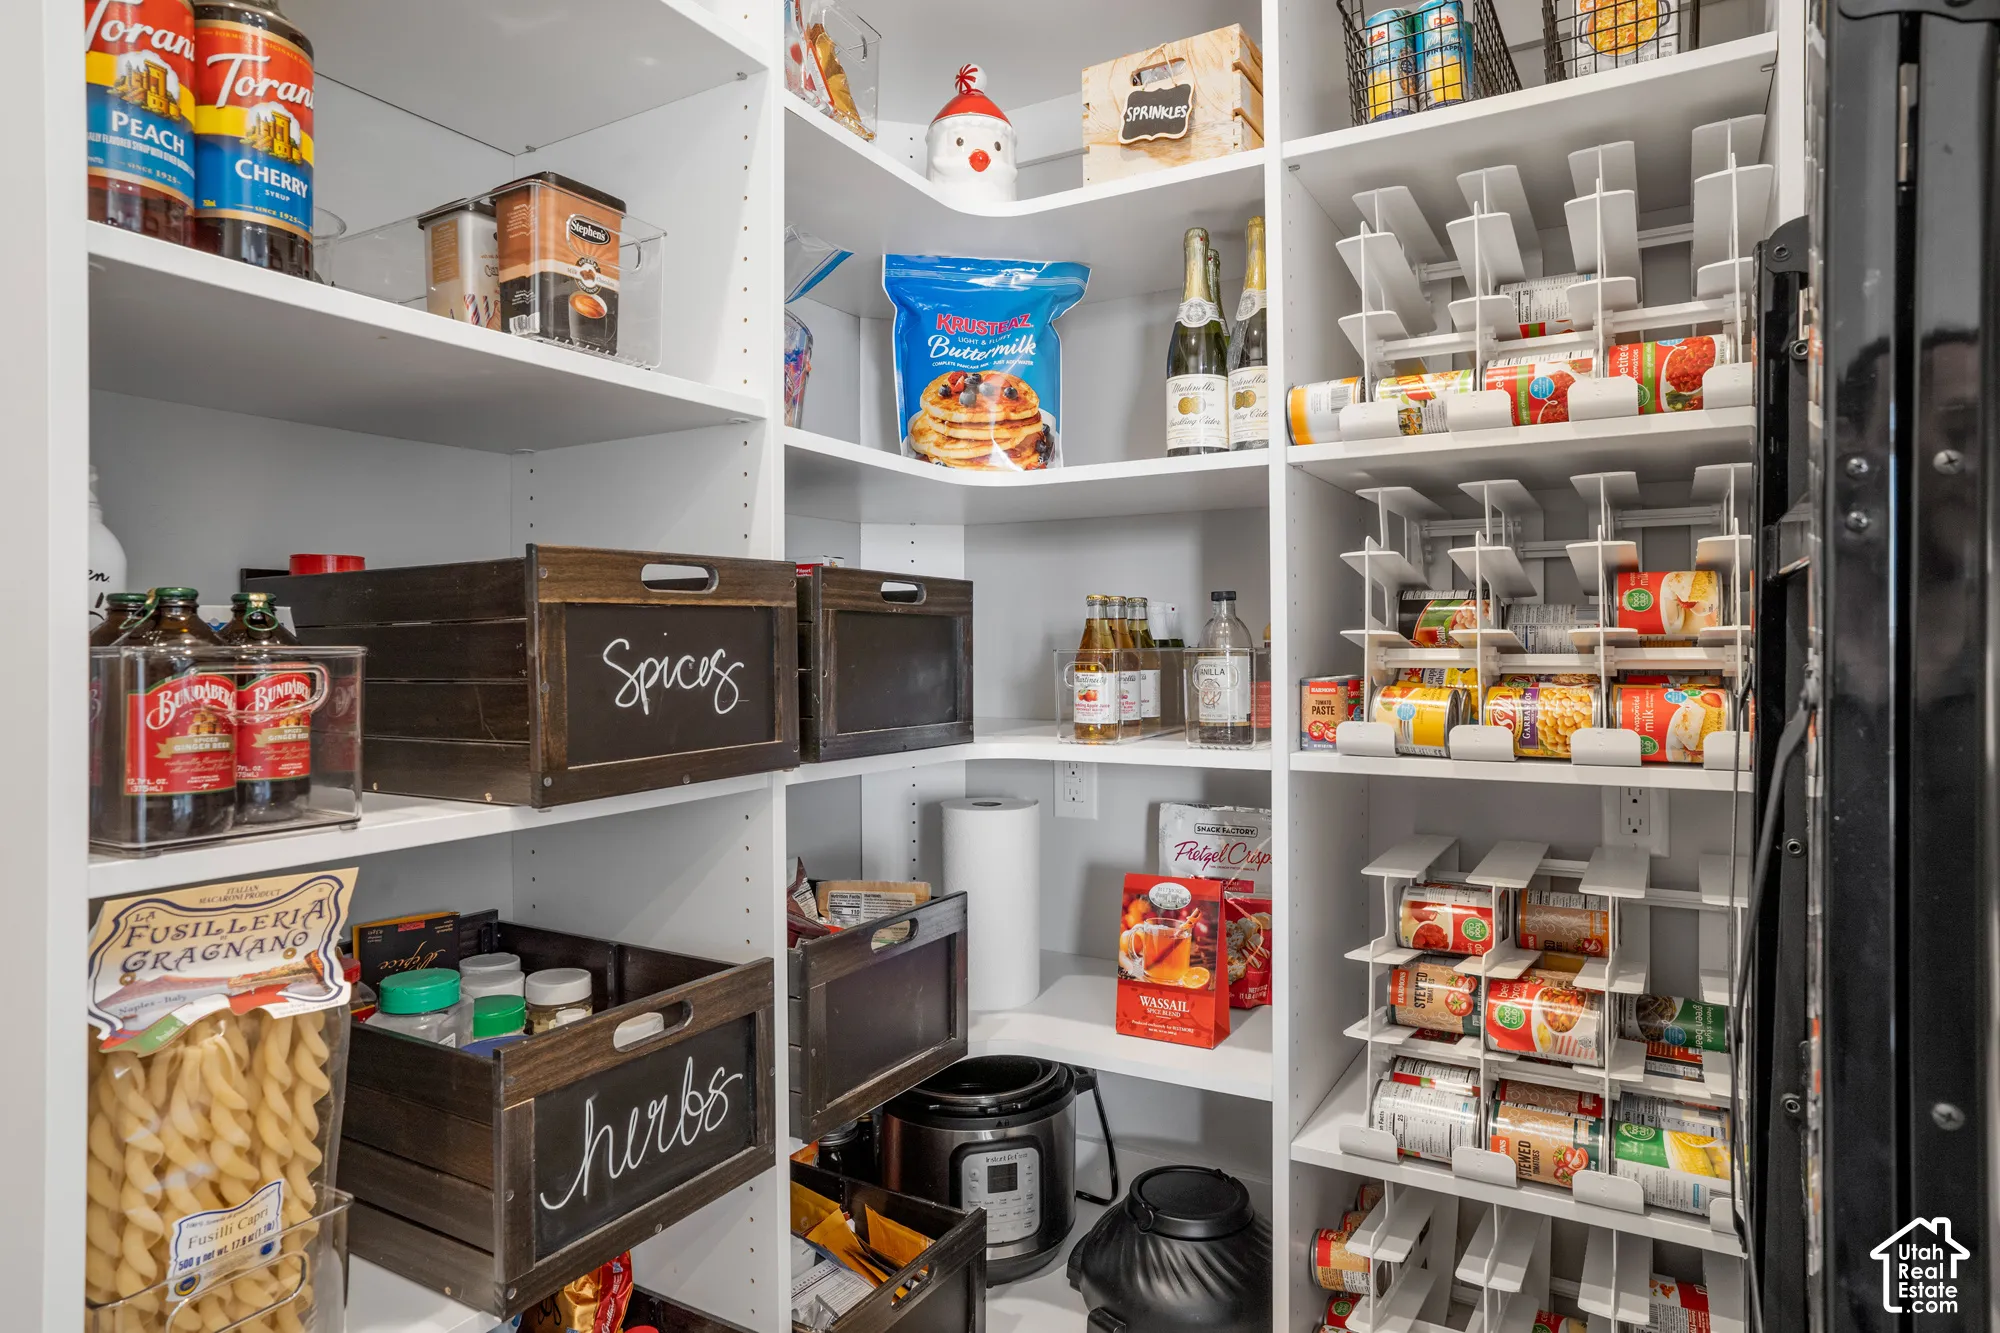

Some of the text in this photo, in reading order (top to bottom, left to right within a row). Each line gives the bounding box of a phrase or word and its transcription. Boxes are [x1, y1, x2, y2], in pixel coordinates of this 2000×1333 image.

[1426, 46, 1464, 57] PINAPPLE
[1126, 105, 1188, 122] SPRINKLES
[111, 110, 185, 156] PEACH
[127, 162, 177, 184] SINCE 1925
[235, 159, 309, 198] CHERRY
[265, 189, 291, 202] SYRUP
[255, 206, 298, 223] SINCE 1925
[571, 220, 606, 242] Stephen's
[927, 334, 1037, 361] Buttermilk
[958, 336, 978, 345] LIGHT
[1199, 415, 1222, 426] Cider
[1637, 572, 1649, 586] mil
[602, 633, 745, 715] Spices
[1199, 668, 1226, 676] ANILLA
[1311, 705, 1336, 716] PASTE
[1632, 695, 1641, 732] evaporated
[1642, 708, 1654, 732] milk
[173, 743, 210, 752] GINGER
[1197, 825, 1221, 833] SNACK
[1174, 840, 1272, 872] Pretzel Crisp
[199, 888, 283, 905] MACARONI PRODUCT
[226, 884, 260, 895] ITALIAN
[121, 897, 326, 949] FUSILLERIA
[134, 910, 156, 922] LA
[121, 929, 309, 973] GRAGNANO
[1397, 971, 1407, 1004] HARMONS
[1414, 971, 1428, 1009] STEWED
[1427, 978, 1435, 1004] TOMATES
[118, 1001, 155, 1016] Naples
[164, 994, 188, 1004] Italy
[1139, 995, 1190, 1013] WASSAIL
[1146, 1007, 1181, 1018] SPICE BLEND
[1502, 1006, 1511, 1024] food
[1511, 1008, 1519, 1025] club
[1693, 1004, 1706, 1049] green bean
[1705, 1006, 1714, 1043] french style
[540, 1056, 743, 1210] herbs
[1518, 1139, 1532, 1177] STEWED
[1532, 1149, 1540, 1175] TOMATOES
[188, 1205, 269, 1250] Fusilli Capri
[178, 1257, 194, 1271] 500
[203, 1250, 215, 1262] net
